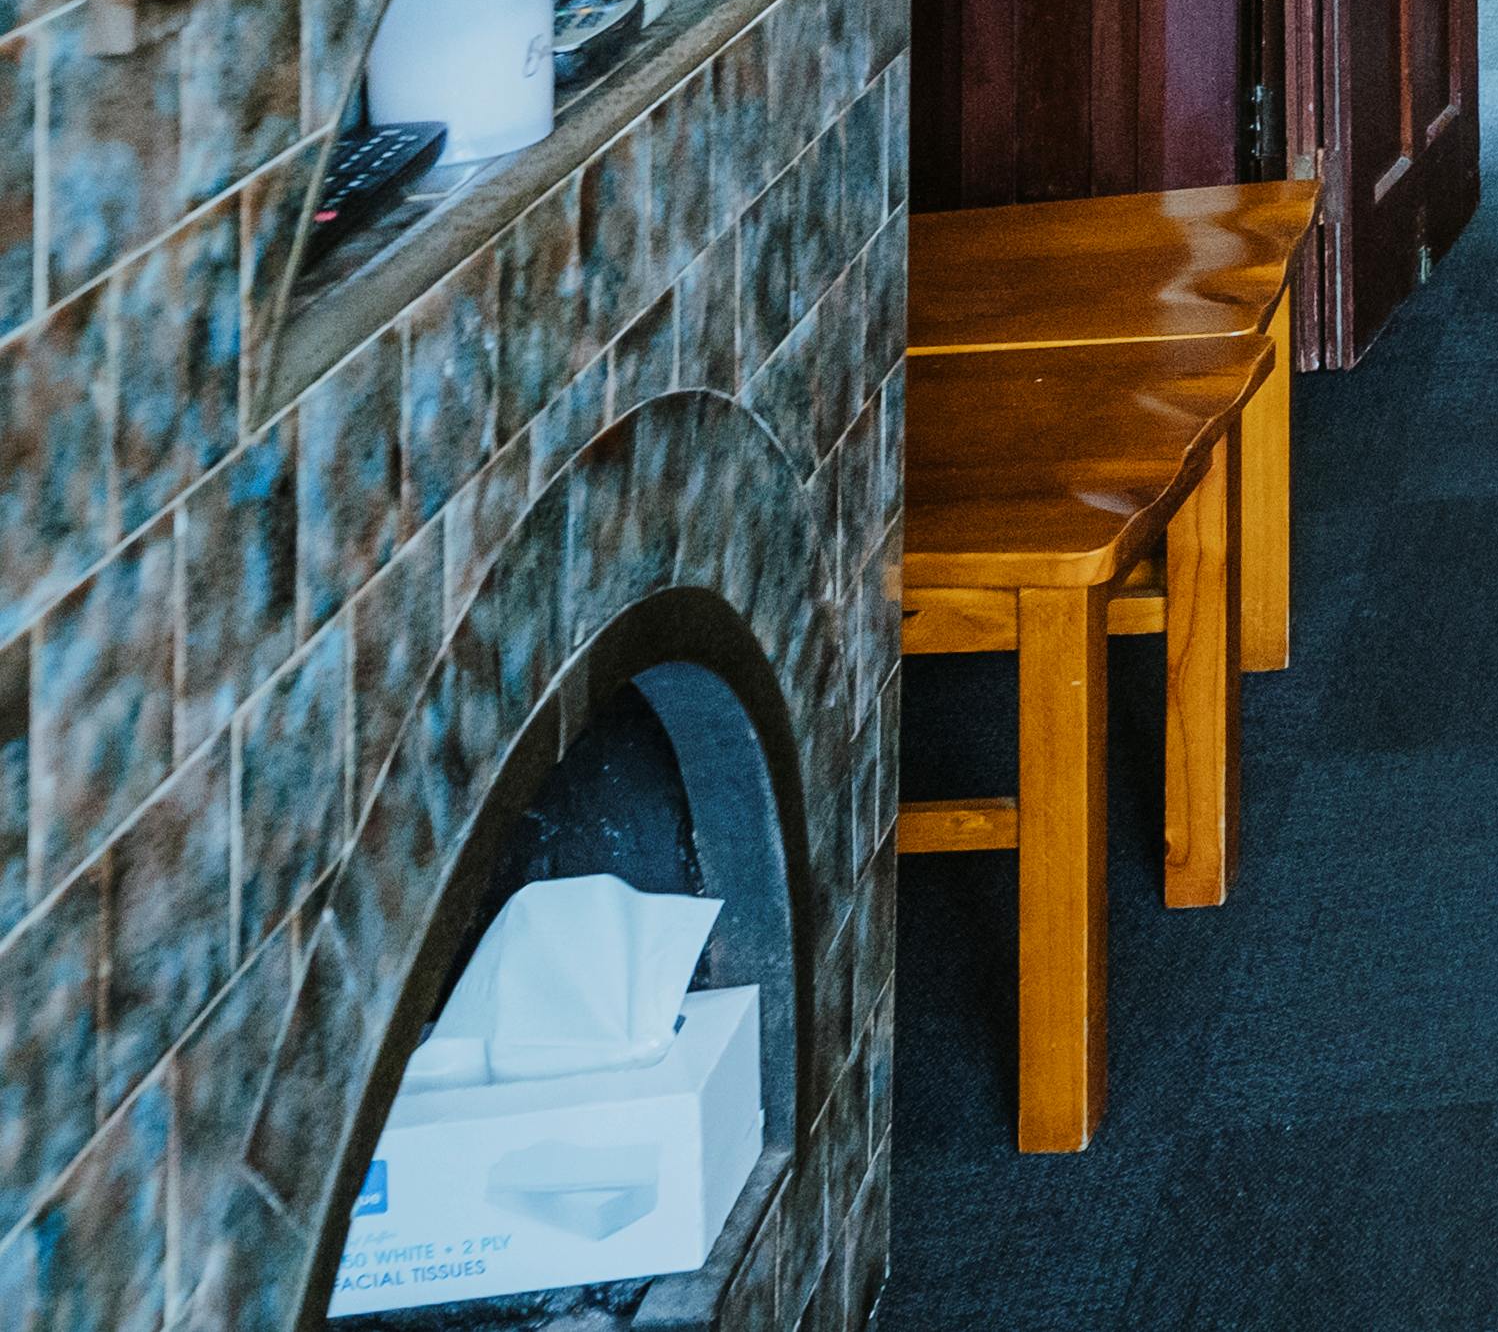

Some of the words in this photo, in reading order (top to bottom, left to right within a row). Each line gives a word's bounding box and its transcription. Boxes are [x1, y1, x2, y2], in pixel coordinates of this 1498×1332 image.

[341, 1252, 367, 1268] 50
[374, 1243, 434, 1265] WHITE
[462, 1240, 473, 1254] 2
[481, 1235, 511, 1253] PLY
[411, 1259, 486, 1283] TISSUES
